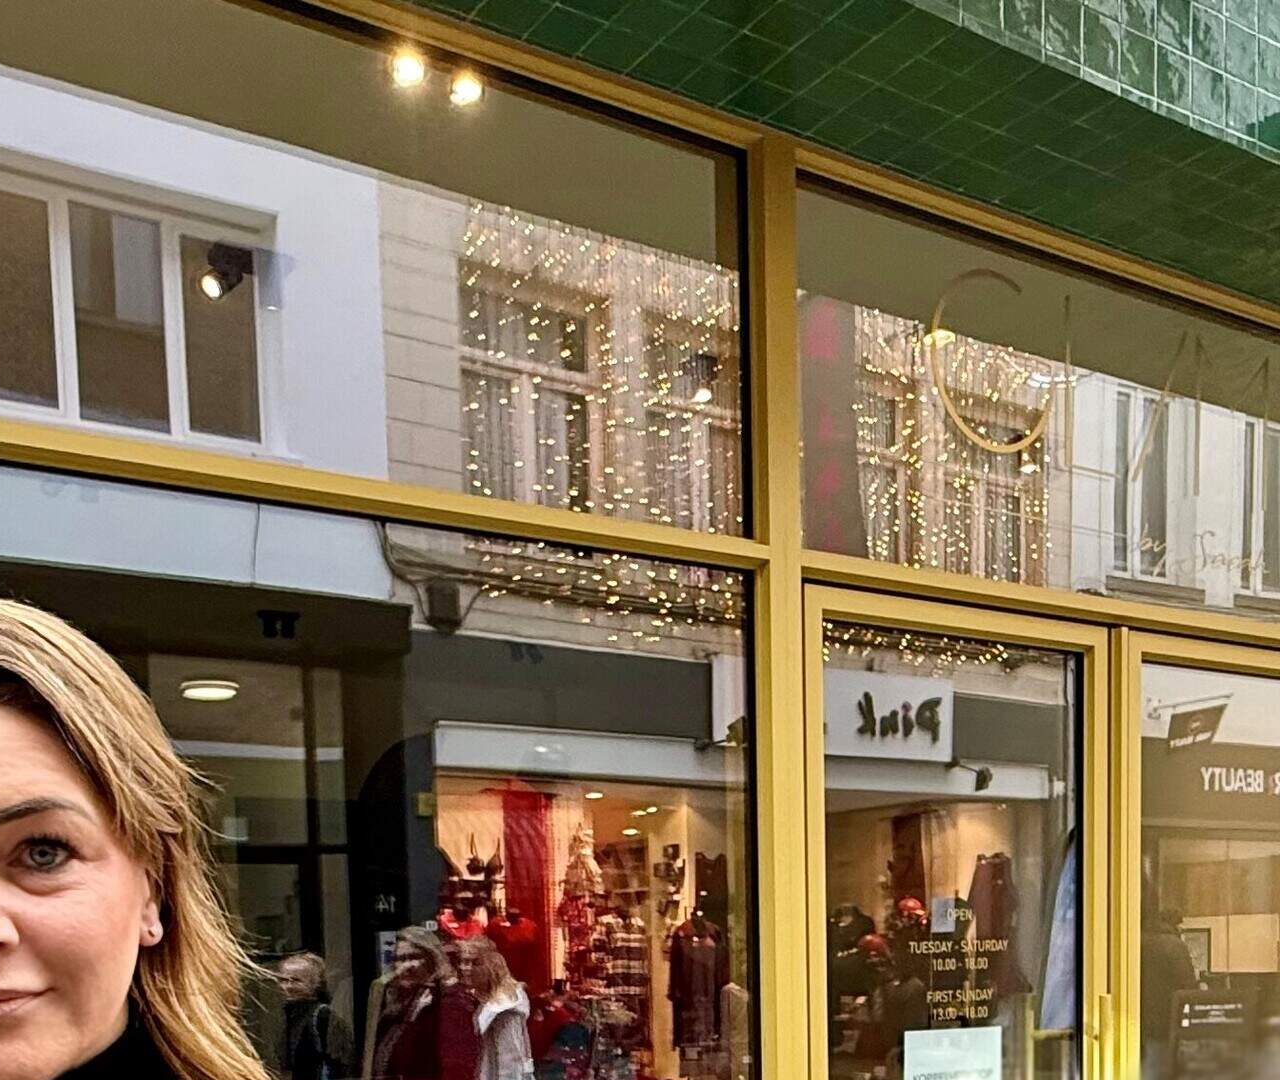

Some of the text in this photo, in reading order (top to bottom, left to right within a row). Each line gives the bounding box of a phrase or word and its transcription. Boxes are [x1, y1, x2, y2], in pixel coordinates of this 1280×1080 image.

[947, 908, 973, 921] OPEN
[908, 940, 953, 954] TUESDAY
[960, 938, 1009, 953] SATURDAY
[932, 958, 956, 971] 10.00
[926, 988, 993, 1003] FIRST SUNDAY
